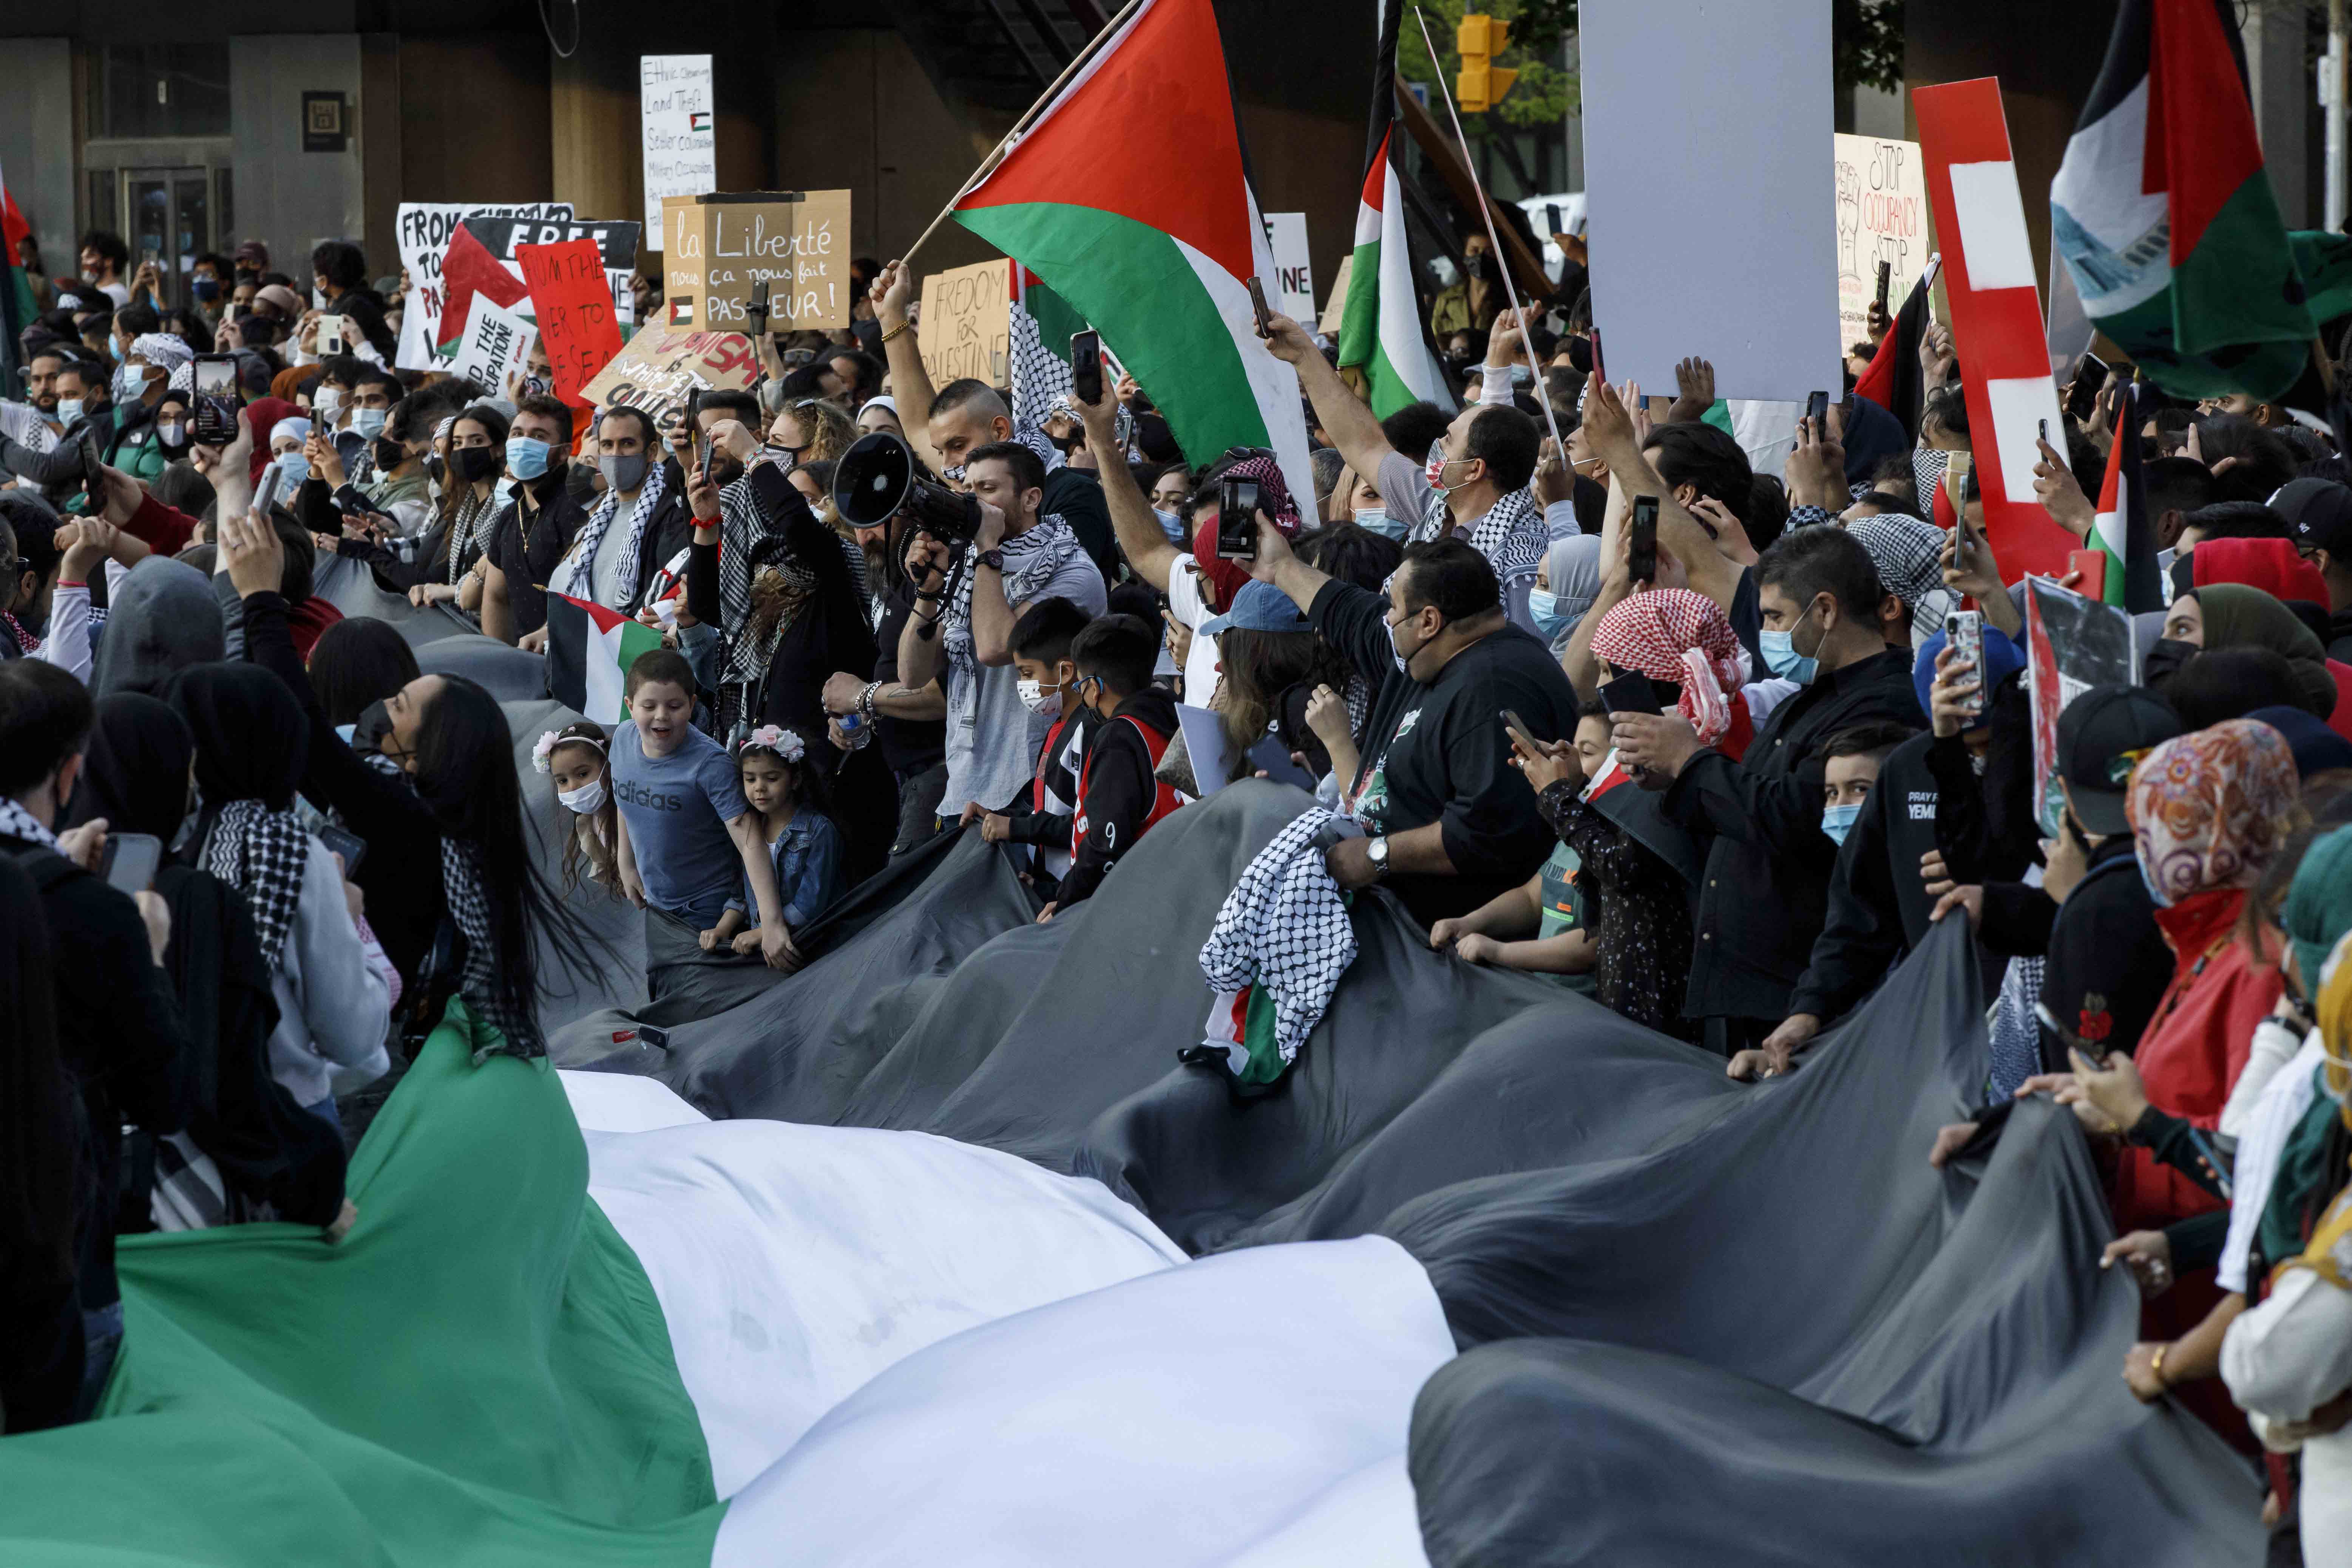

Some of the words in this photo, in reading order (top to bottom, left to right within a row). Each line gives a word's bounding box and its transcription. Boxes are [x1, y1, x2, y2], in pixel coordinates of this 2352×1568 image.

[646, 92, 672, 114] Land
[1870, 141, 1904, 191] STOP
[1864, 192, 1918, 236] OCCUPANCY
[676, 210, 702, 259] la
[716, 212, 831, 258] Liberté
[418, 252, 442, 280] TO
[1871, 234, 1907, 277] STOP
[709, 269, 737, 287] ça
[746, 269, 793, 281] nous
[798, 261, 828, 284] fait
[576, 302, 605, 335] TO
[707, 297, 746, 321] PAS
[767, 291, 823, 320] EUR
[475, 313, 497, 352] THE
[957, 315, 979, 343] FOR
[921, 334, 1006, 391] PALESTINE
[1908, 791, 1933, 802] PRAY
